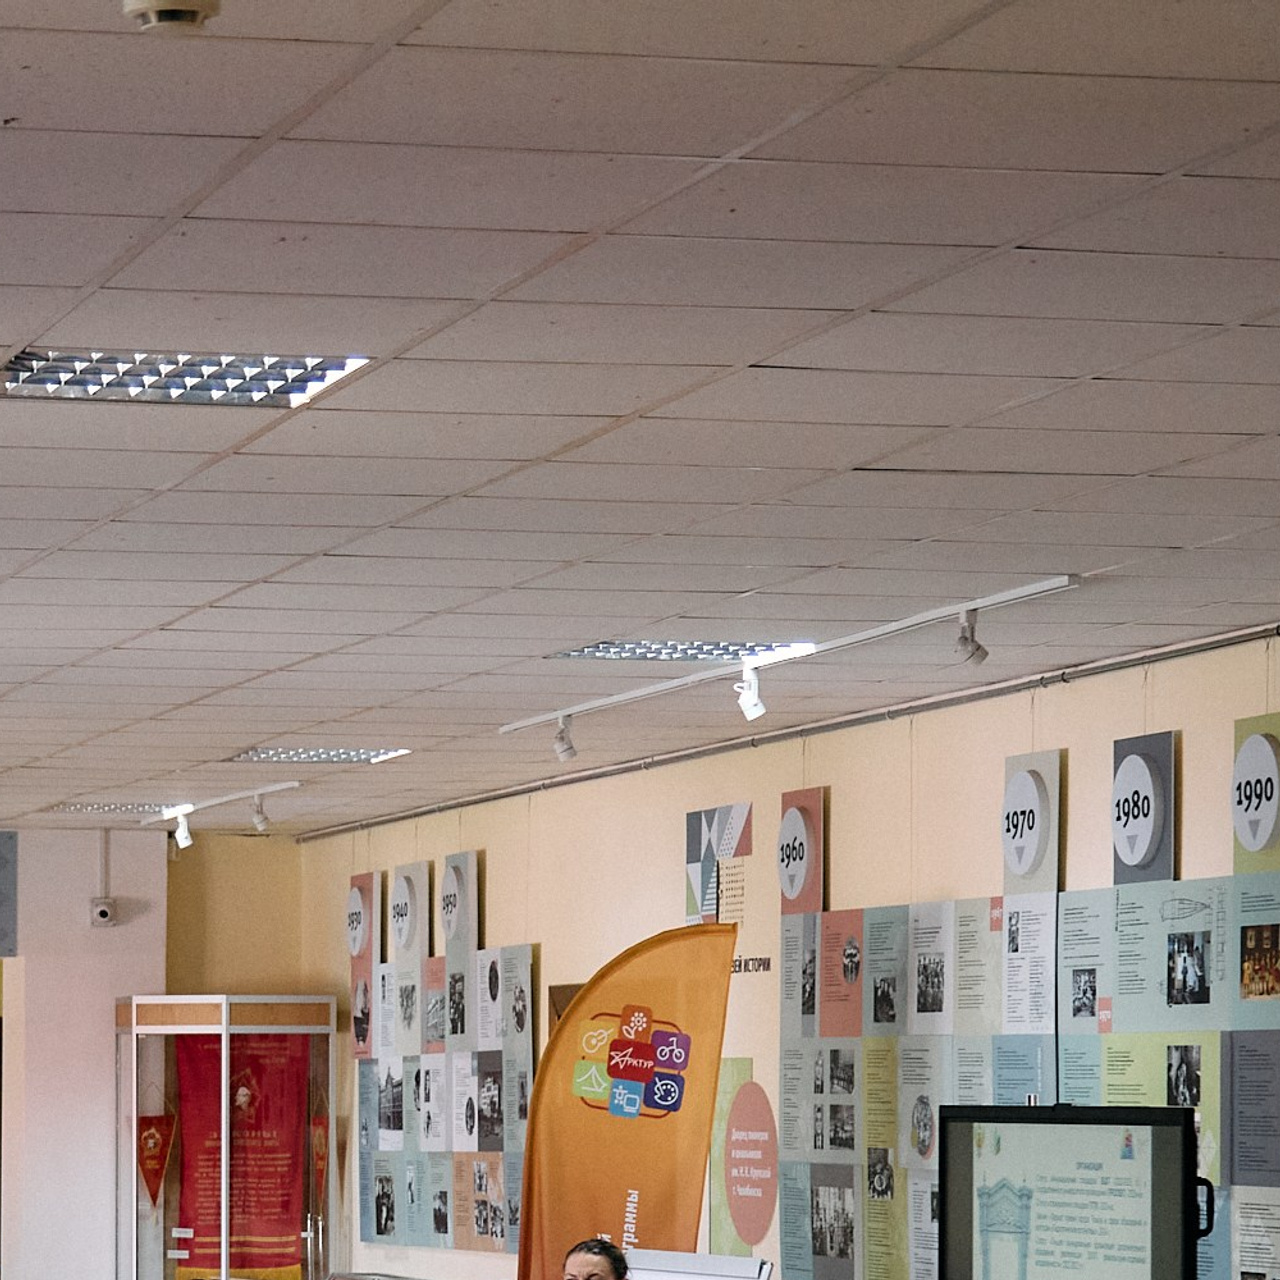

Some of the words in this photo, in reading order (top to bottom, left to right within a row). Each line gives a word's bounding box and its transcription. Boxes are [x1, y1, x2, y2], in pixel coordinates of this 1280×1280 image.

[1115, 789, 1151, 828] 1980
[1236, 776, 1274, 813] 1990
[1005, 808, 1036, 840] 1970
[780, 836, 805, 869] 1960
[392, 902, 408, 923] 1940
[442, 893, 457, 915] 1950
[348, 911, 361, 931] 1930
[622, 1189, 639, 1254] граммы
